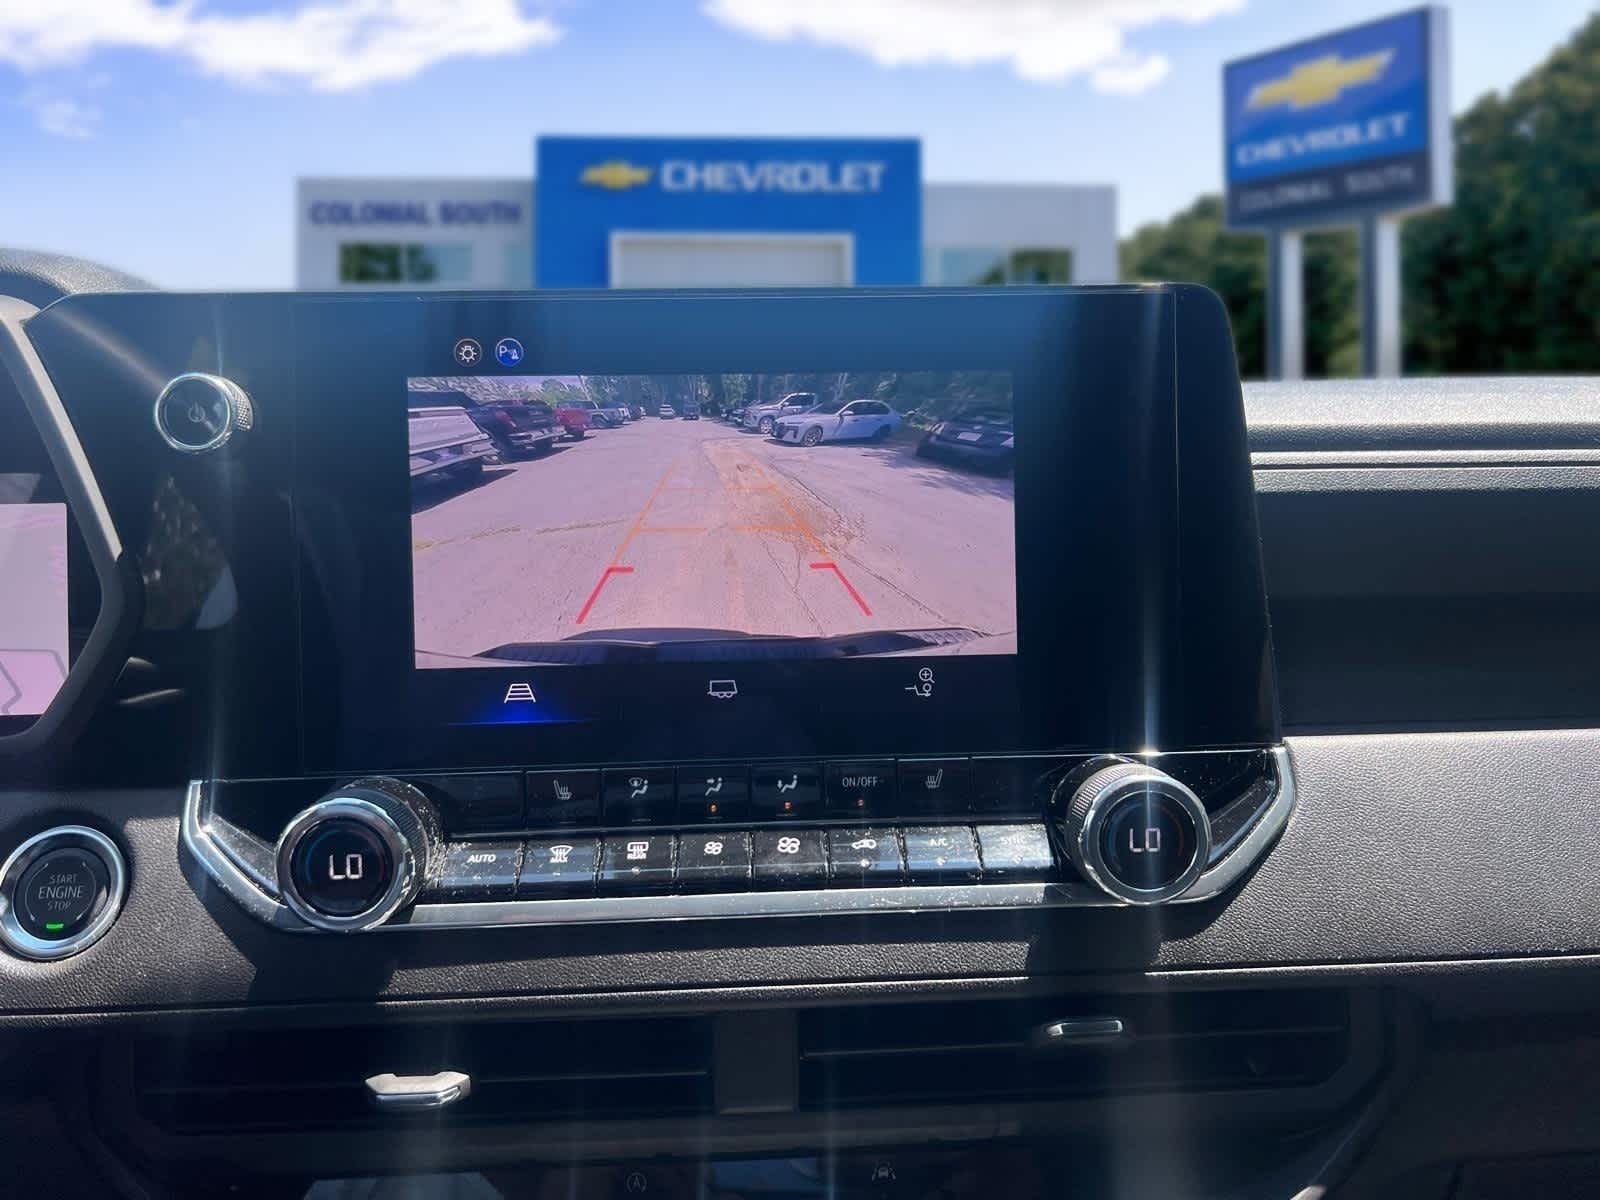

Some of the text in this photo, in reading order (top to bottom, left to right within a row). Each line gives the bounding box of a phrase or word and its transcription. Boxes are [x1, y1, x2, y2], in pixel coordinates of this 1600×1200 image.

[1236, 113, 1408, 167] CHEVROLET
[661, 159, 885, 193] CHEVROLET
[842, 775, 879, 788] ON/OFF
[466, 853, 497, 864] AUTO
[48, 873, 78, 885] START
[38, 885, 85, 900] ENGINE
[47, 900, 72, 912] STOP
